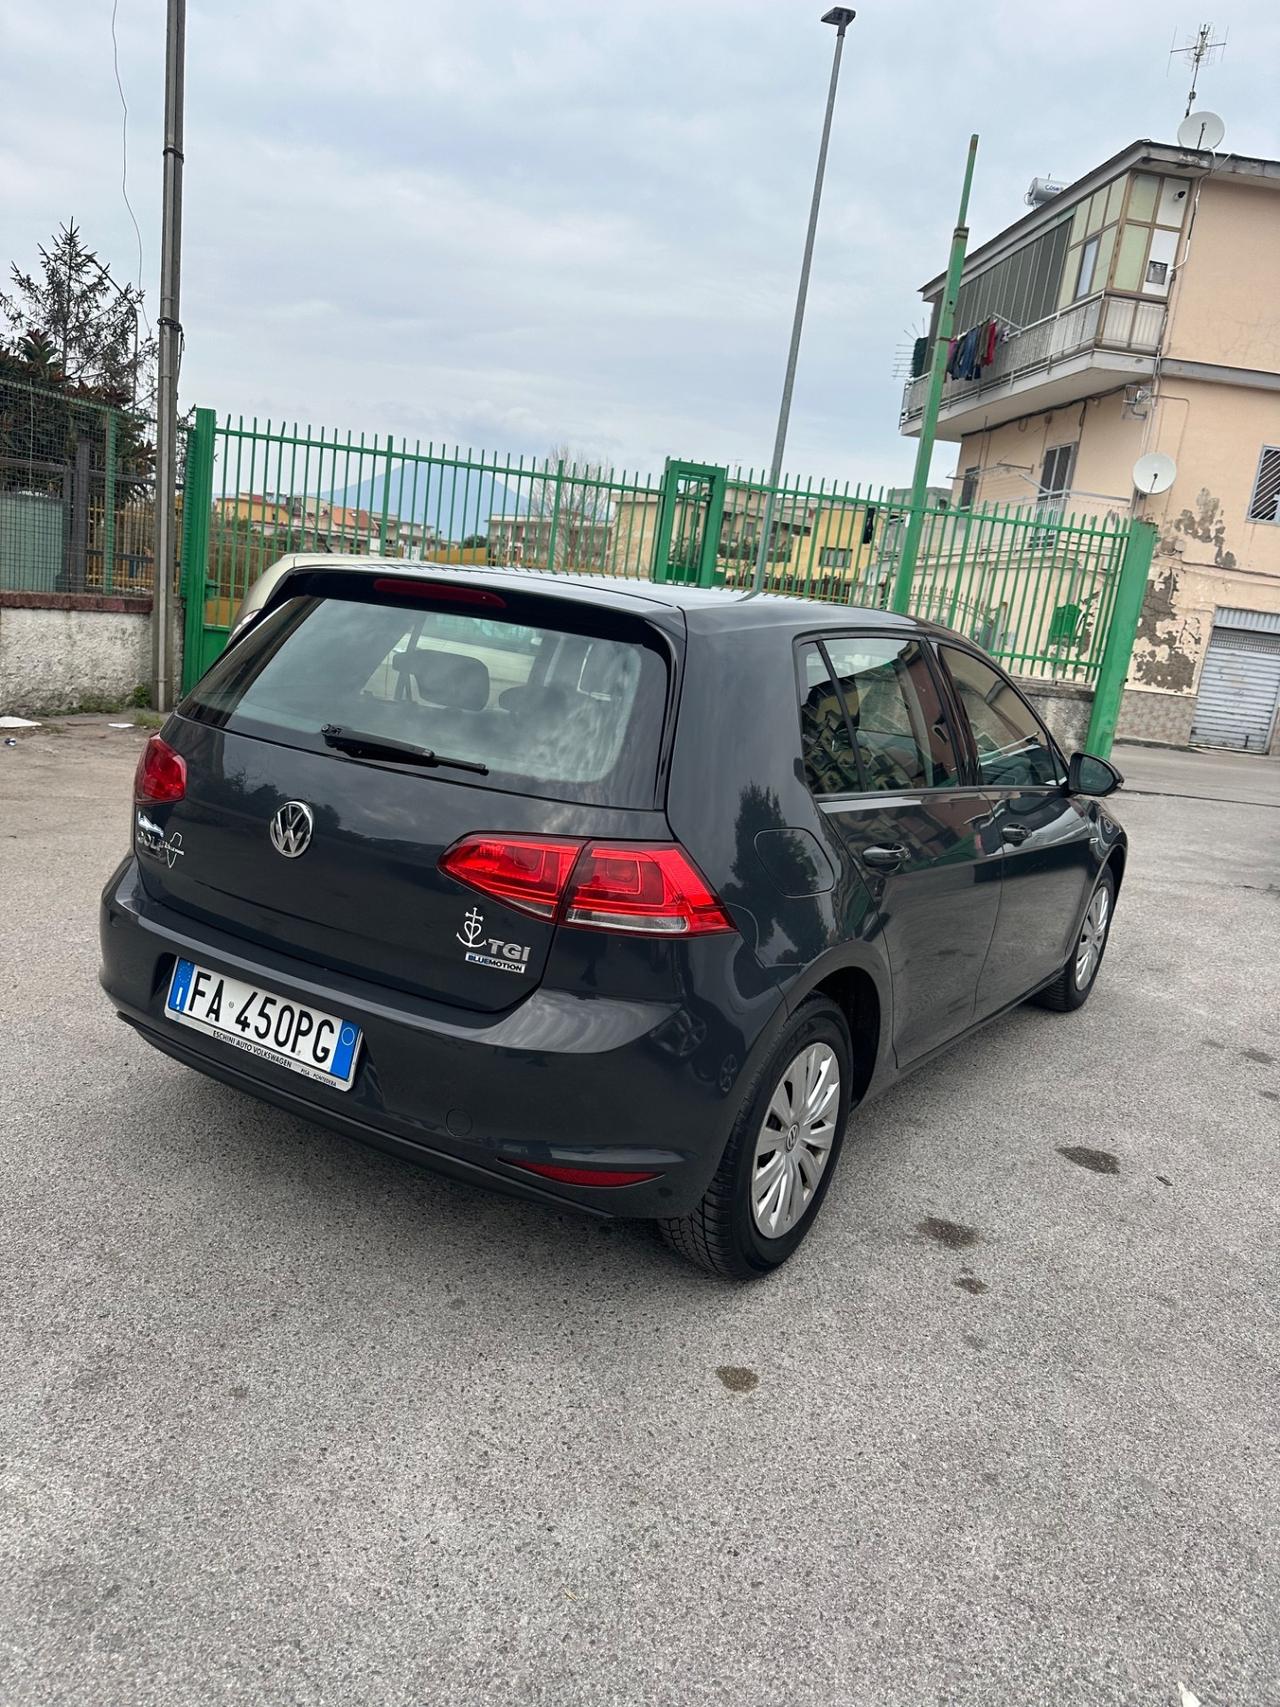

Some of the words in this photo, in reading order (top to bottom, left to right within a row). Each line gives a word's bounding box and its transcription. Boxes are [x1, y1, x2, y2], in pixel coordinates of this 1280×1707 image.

[467, 954, 522, 971] BLUEMOTION
[488, 938, 531, 962] TGI
[188, 971, 225, 1022] FA
[235, 991, 335, 1063] 450PG
[212, 1030, 235, 1044] ESCHINI
[236, 1040, 252, 1052] AUTO
[253, 1047, 292, 1068] VOLKSWAGEN
